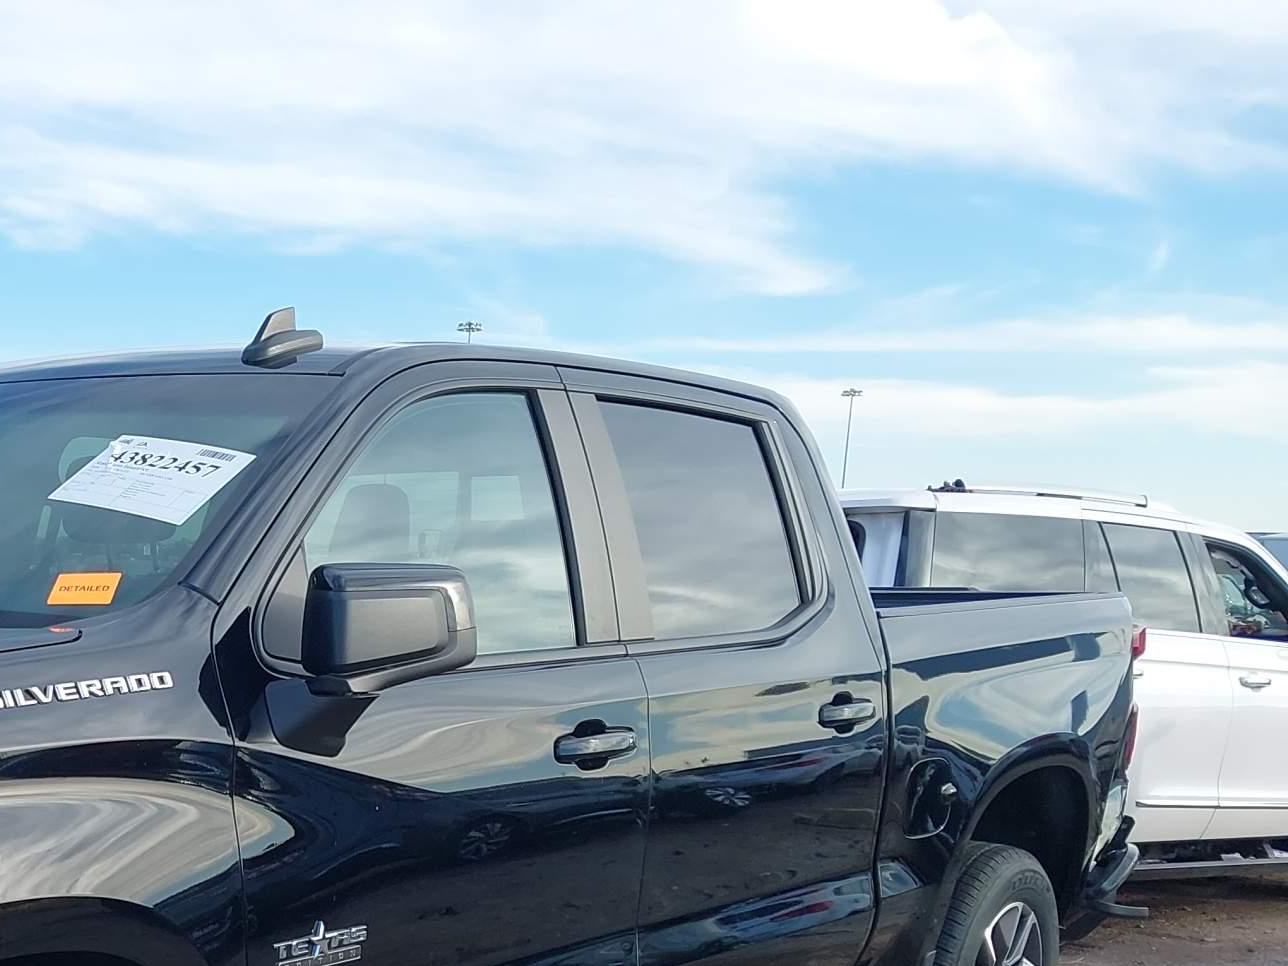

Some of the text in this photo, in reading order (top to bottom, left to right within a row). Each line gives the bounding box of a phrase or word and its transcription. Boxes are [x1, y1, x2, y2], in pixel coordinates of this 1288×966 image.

[111, 450, 221, 478] 43822457
[59, 583, 110, 593] DETAILED
[269, 919, 368, 959] TEXAS
